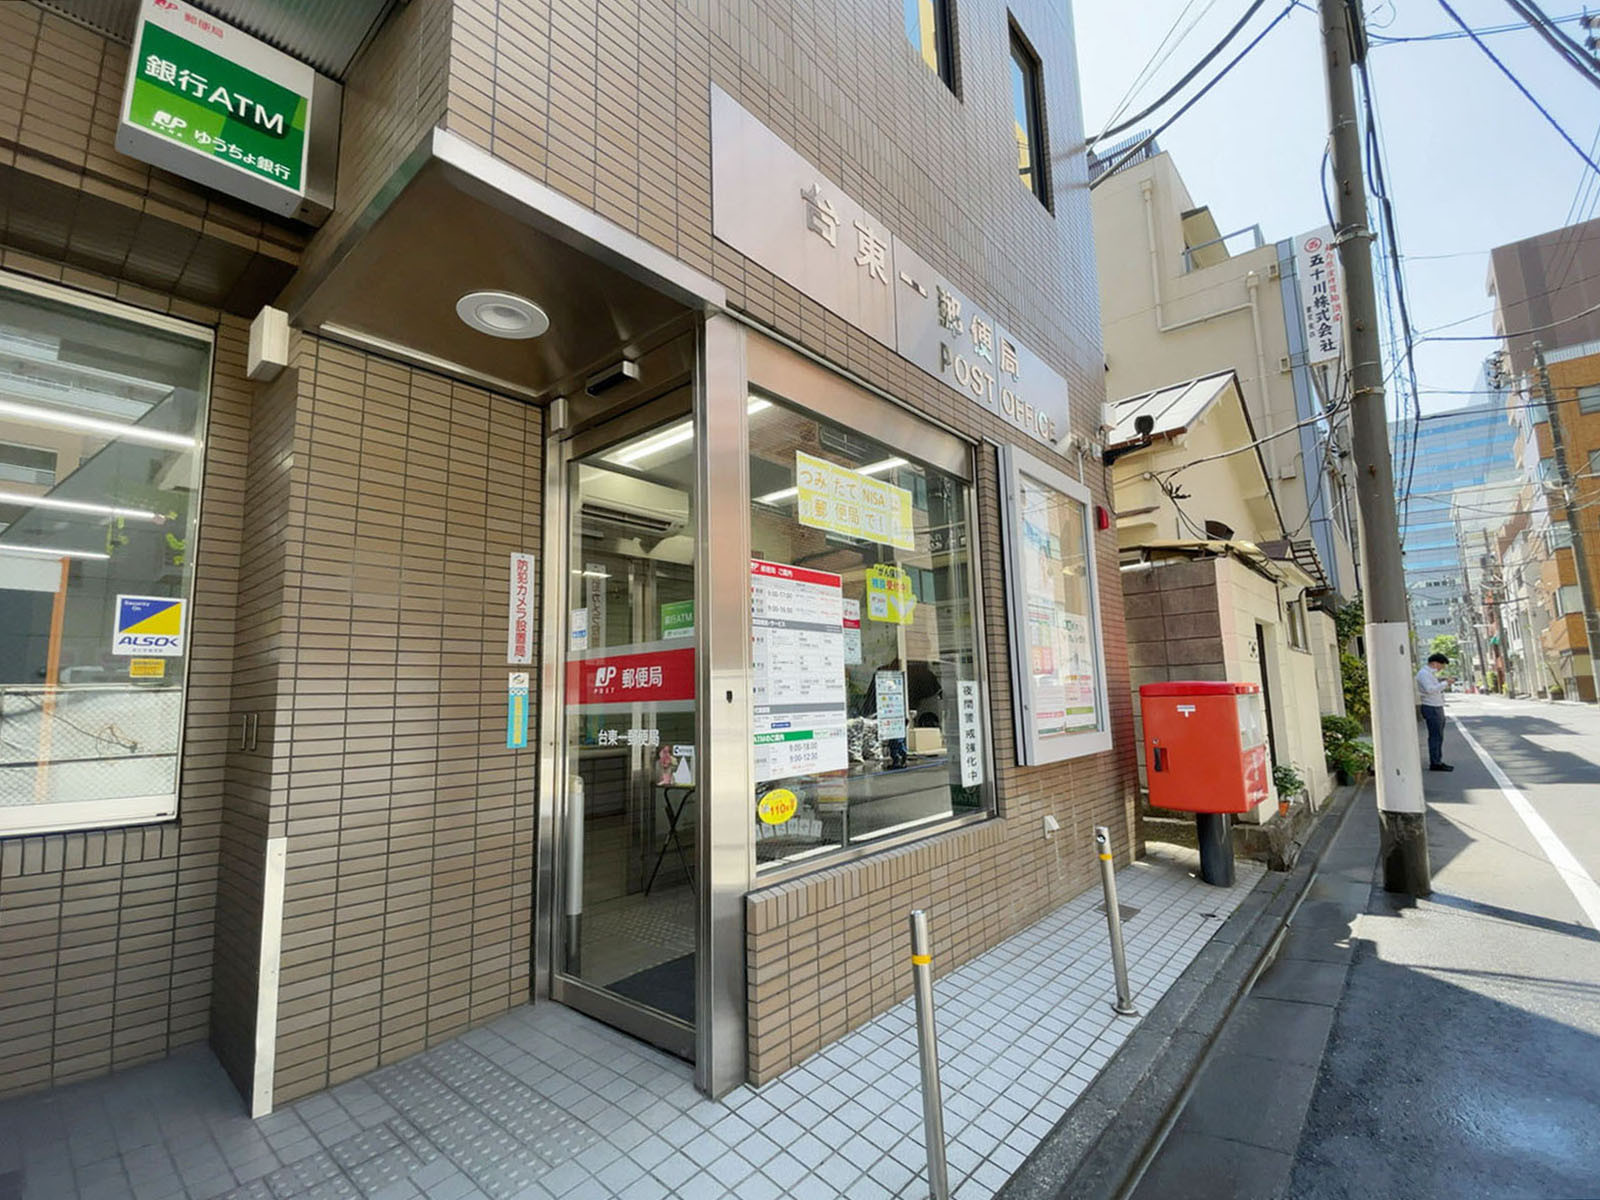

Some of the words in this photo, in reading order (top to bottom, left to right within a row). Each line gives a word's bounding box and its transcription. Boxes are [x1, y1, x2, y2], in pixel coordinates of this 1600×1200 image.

[144, 55, 284, 135] 銀行ATM
[193, 129, 291, 180] ゆうちょ銀行
[800, 182, 1020, 383] 台東一郵便局
[1309, 253, 1337, 352] 五十川株式会社
[940, 342, 996, 404] POST
[1000, 386, 1057, 445] OFFICE
[118, 635, 179, 648] ALSOK
[514, 558, 529, 657] 防犯カメラ設置局
[621, 665, 663, 689] 郵便局
[598, 728, 660, 747] 台東一郵便局
